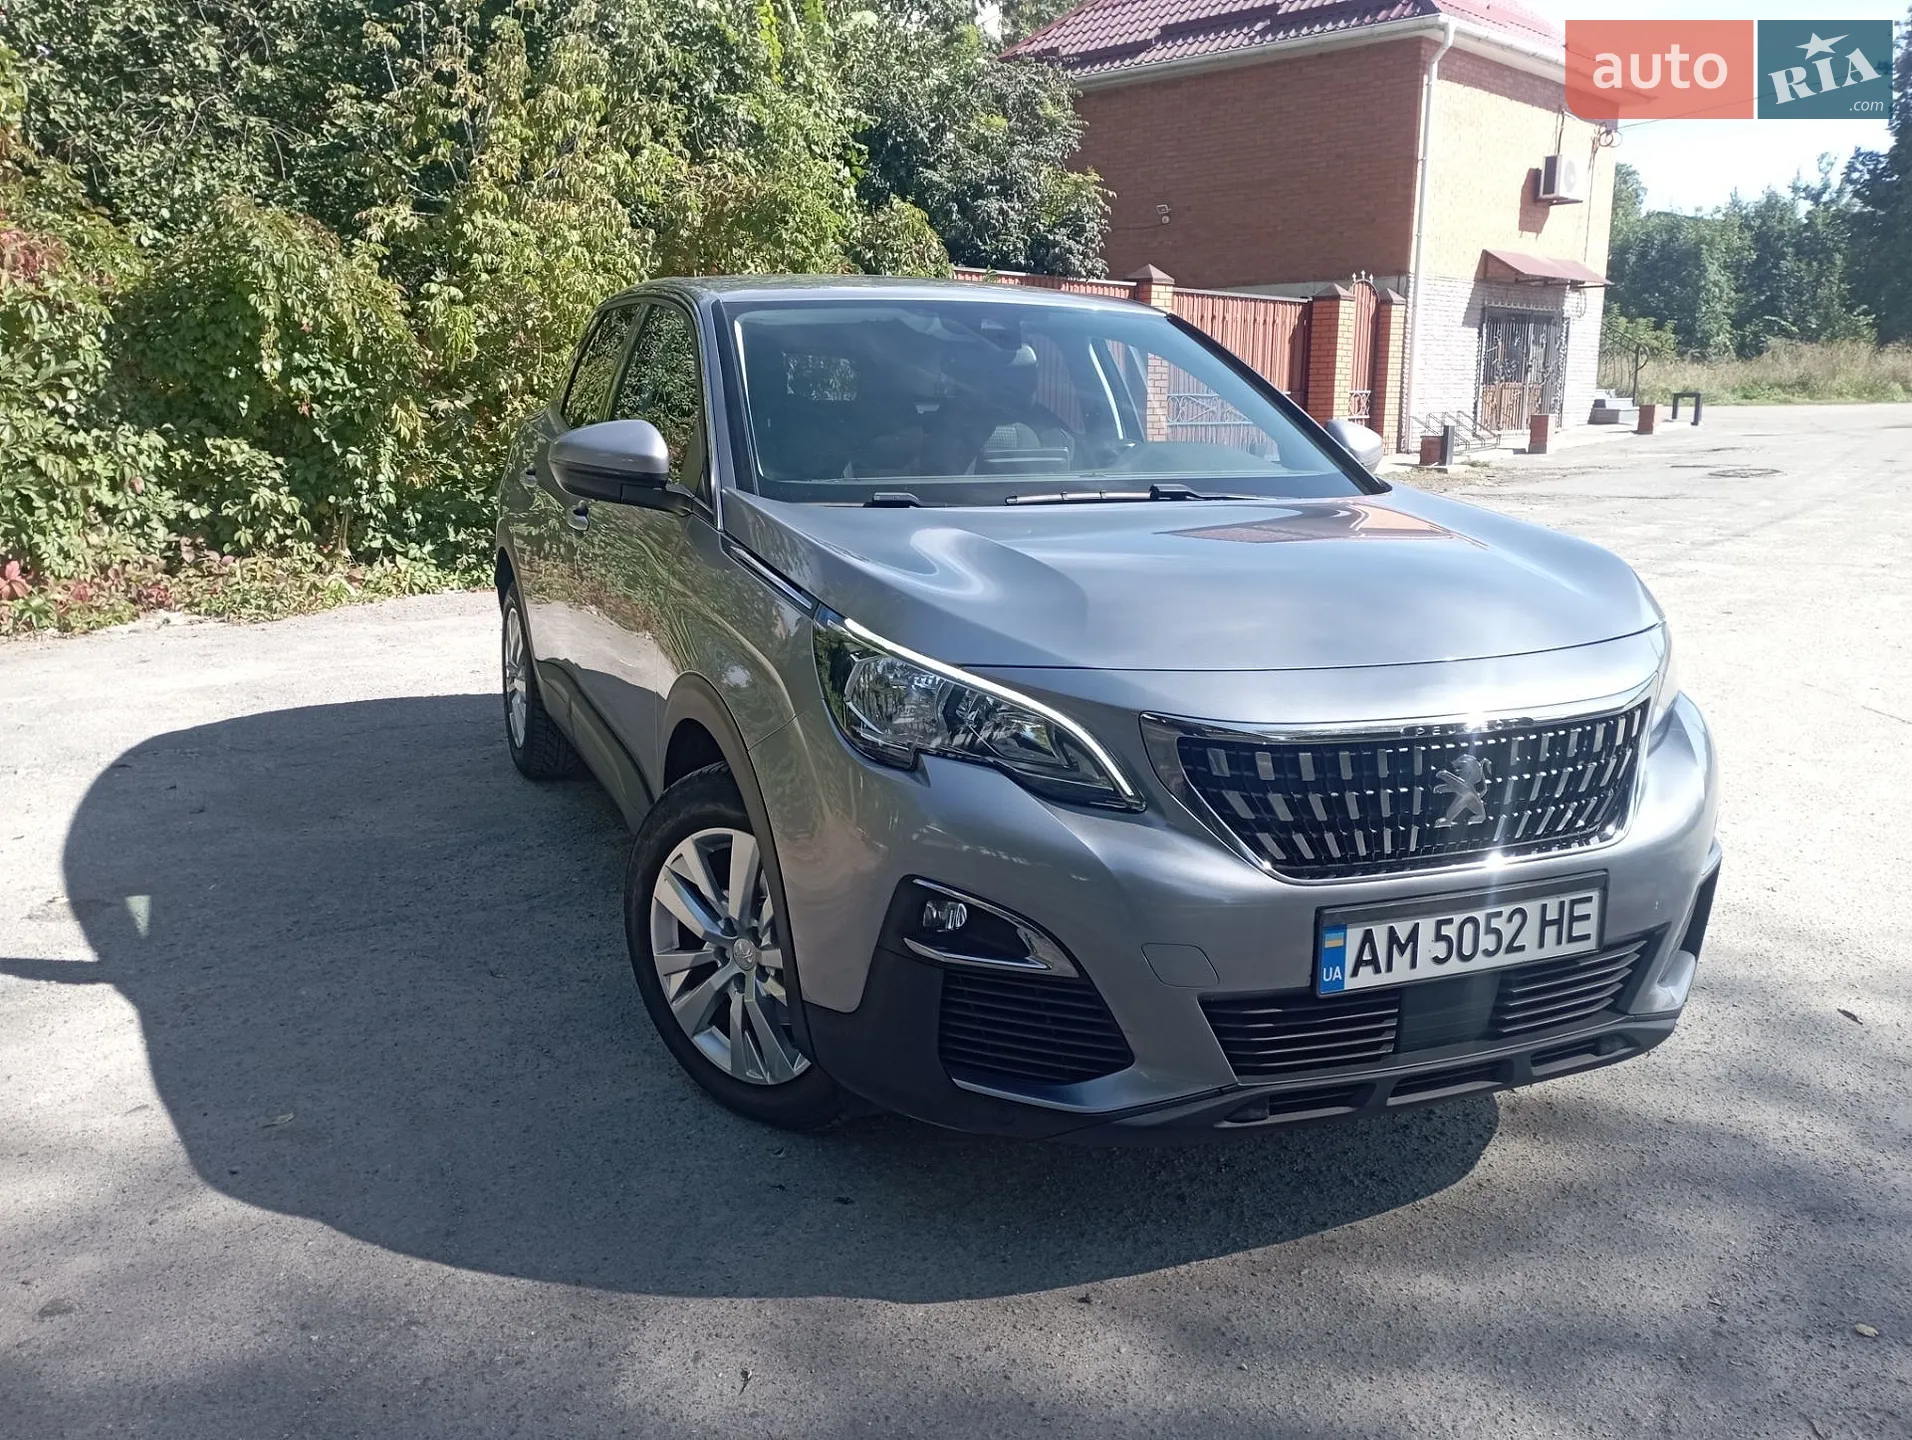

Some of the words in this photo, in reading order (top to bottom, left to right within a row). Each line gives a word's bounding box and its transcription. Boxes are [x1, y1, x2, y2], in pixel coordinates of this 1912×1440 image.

[1350, 922, 1420, 978] AM
[1431, 907, 1528, 965] 5052
[1537, 895, 1594, 950] HE
[1322, 965, 1343, 983] UA
